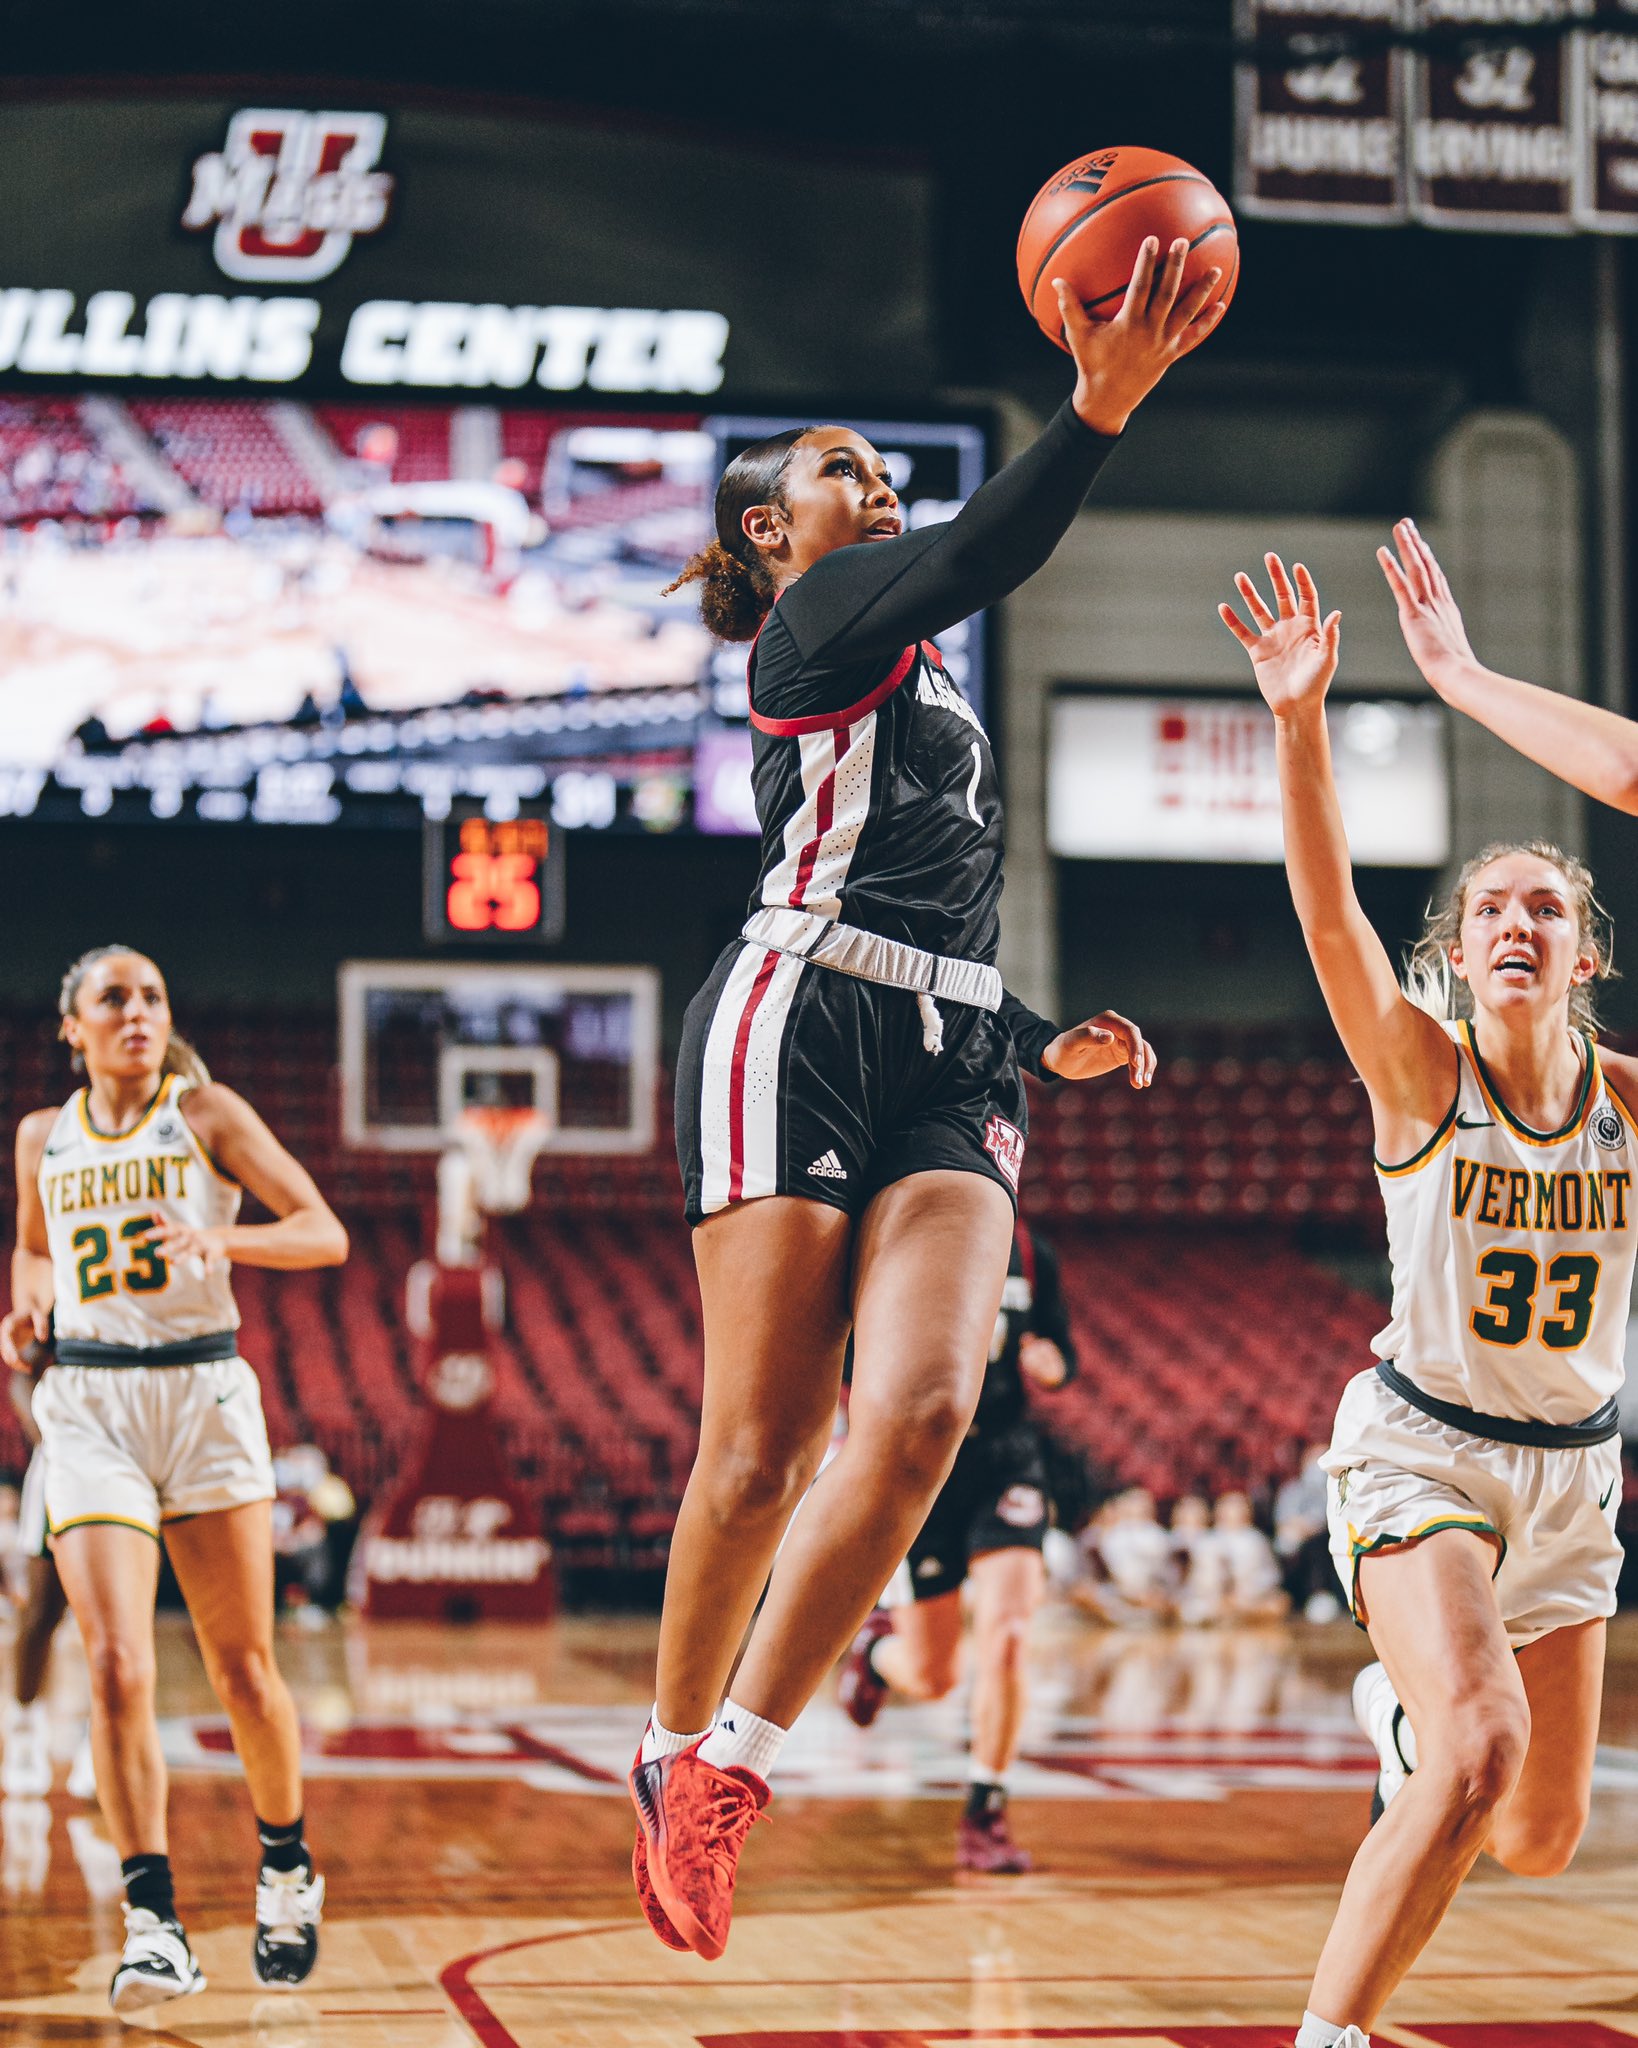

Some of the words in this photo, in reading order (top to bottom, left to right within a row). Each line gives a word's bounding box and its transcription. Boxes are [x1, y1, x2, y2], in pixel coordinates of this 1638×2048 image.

[340, 301, 730, 394] CENTER
[46, 1155, 191, 1219] VERMONT
[807, 1166, 847, 1180] adidas
[1451, 1155, 1632, 1233] VERMONT
[71, 1211, 170, 1304] 23
[1468, 1246, 1602, 1353] 33
